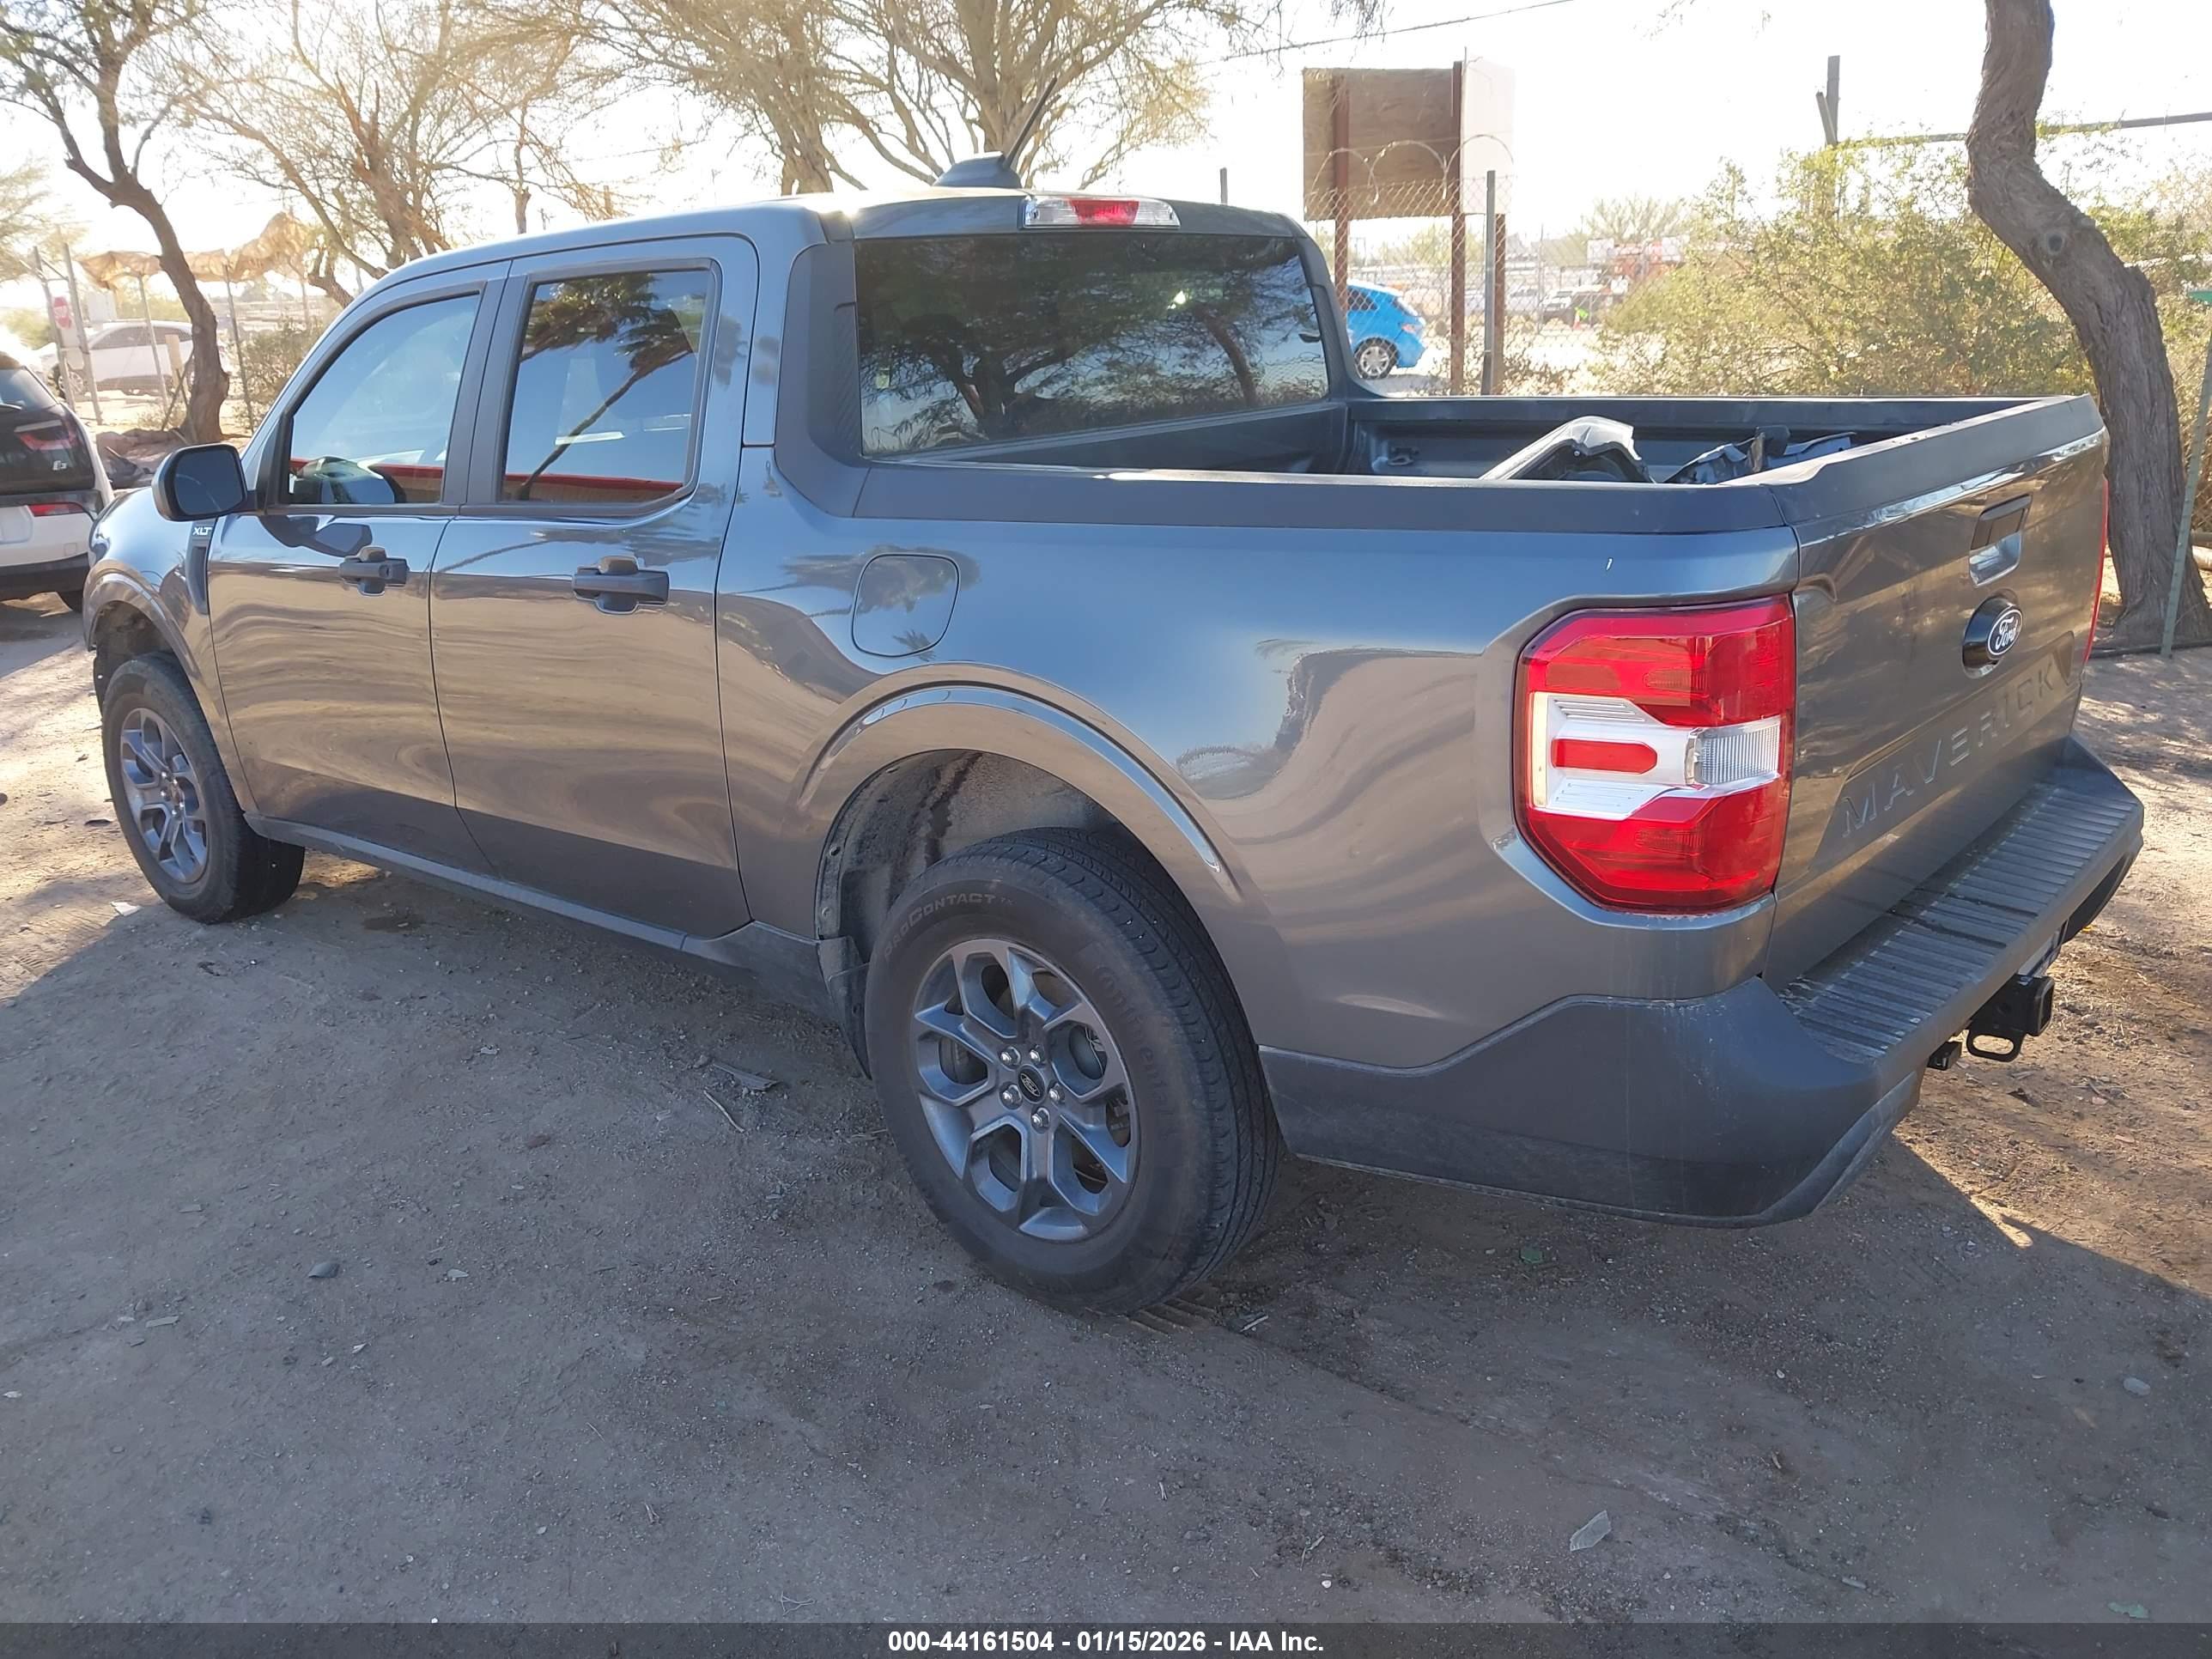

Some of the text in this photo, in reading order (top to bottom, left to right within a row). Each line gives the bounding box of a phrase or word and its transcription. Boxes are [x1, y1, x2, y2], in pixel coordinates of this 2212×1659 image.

[192, 526, 213, 536] XLT
[1995, 616, 2019, 650] Ford
[1842, 659, 2055, 839] MAVERICK
